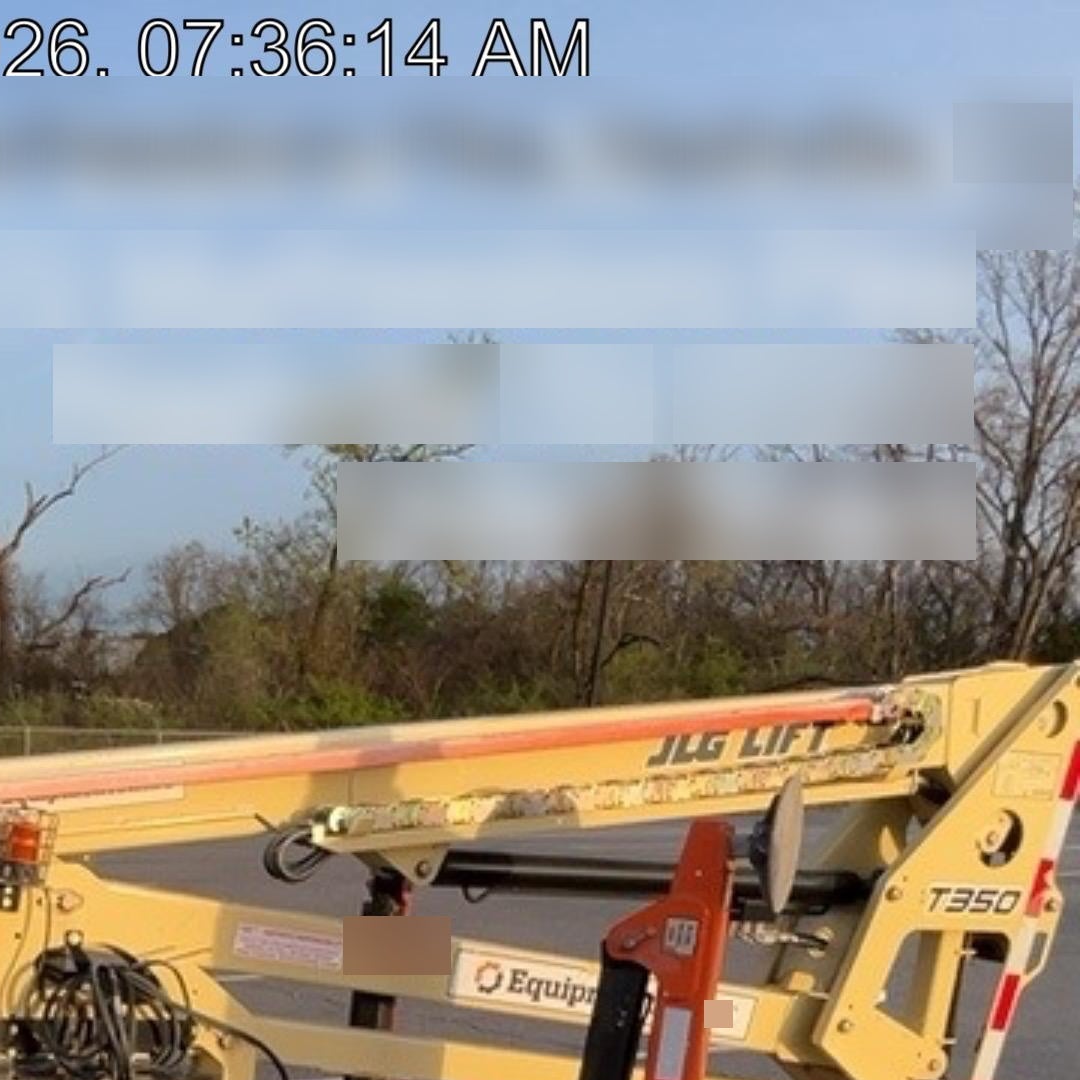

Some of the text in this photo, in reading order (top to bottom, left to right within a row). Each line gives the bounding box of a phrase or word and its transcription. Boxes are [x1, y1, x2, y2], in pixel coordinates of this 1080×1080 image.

[647, 720, 834, 767] JLG LIFT
[929, 887, 1021, 914] T350
